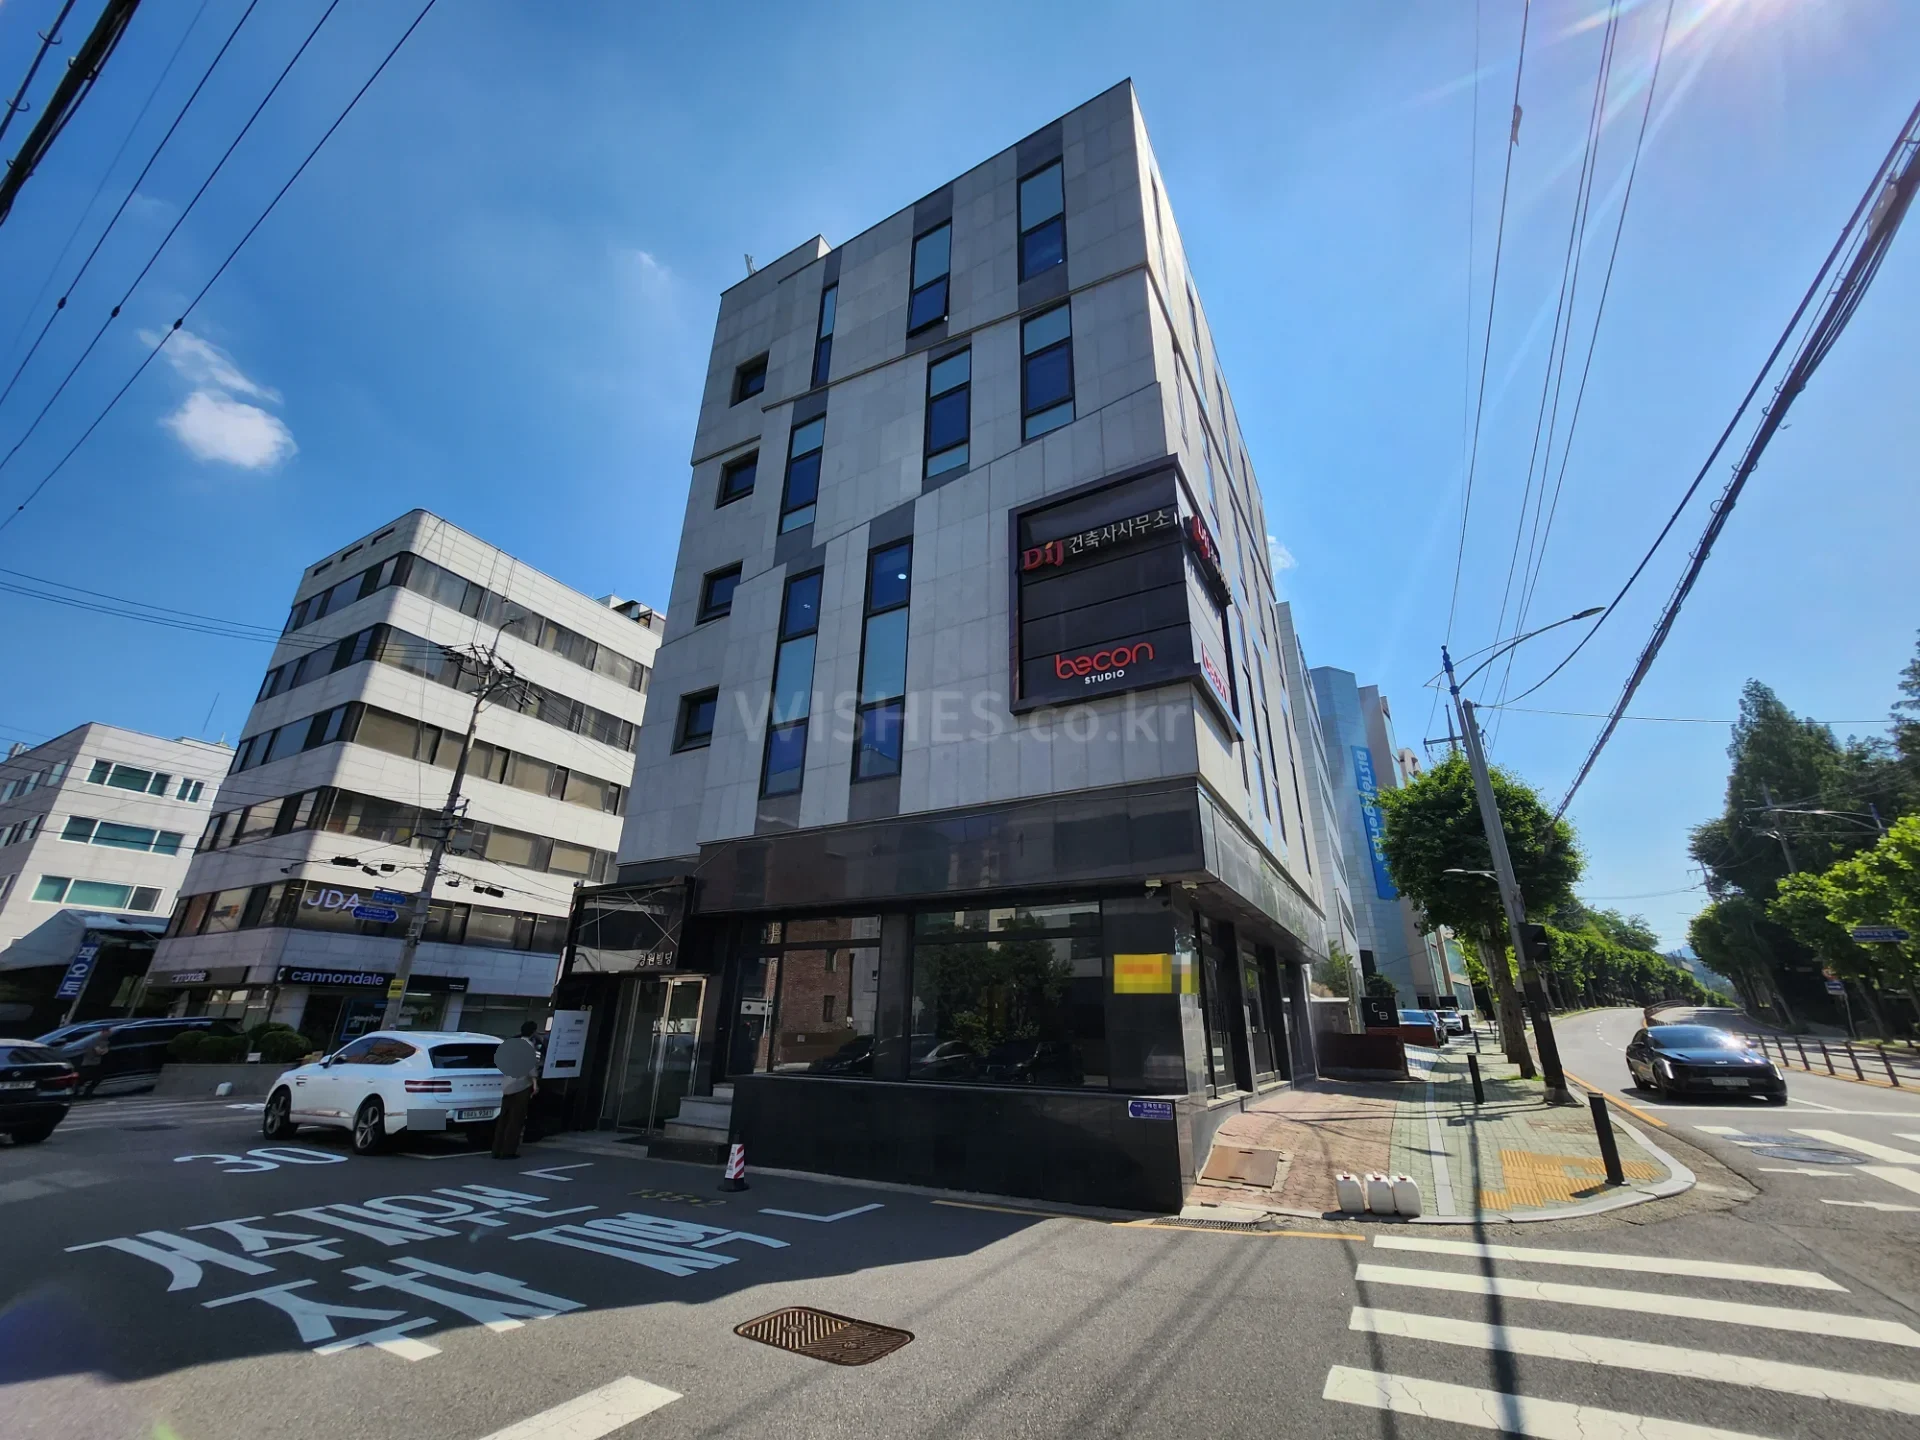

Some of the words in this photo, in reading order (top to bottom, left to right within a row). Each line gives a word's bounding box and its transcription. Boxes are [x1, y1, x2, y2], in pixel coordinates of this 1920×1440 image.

[1068, 510, 1171, 554] 건축사사무소
[1054, 642, 1155, 680] becon
[1084, 669, 1125, 684] STUDIO
[307, 888, 360, 910] JDA
[291, 970, 384, 986] cannondale
[173, 1147, 349, 1173] 30
[64, 1184, 599, 1292] 거주자우선
[201, 1256, 587, 1361] 주차
